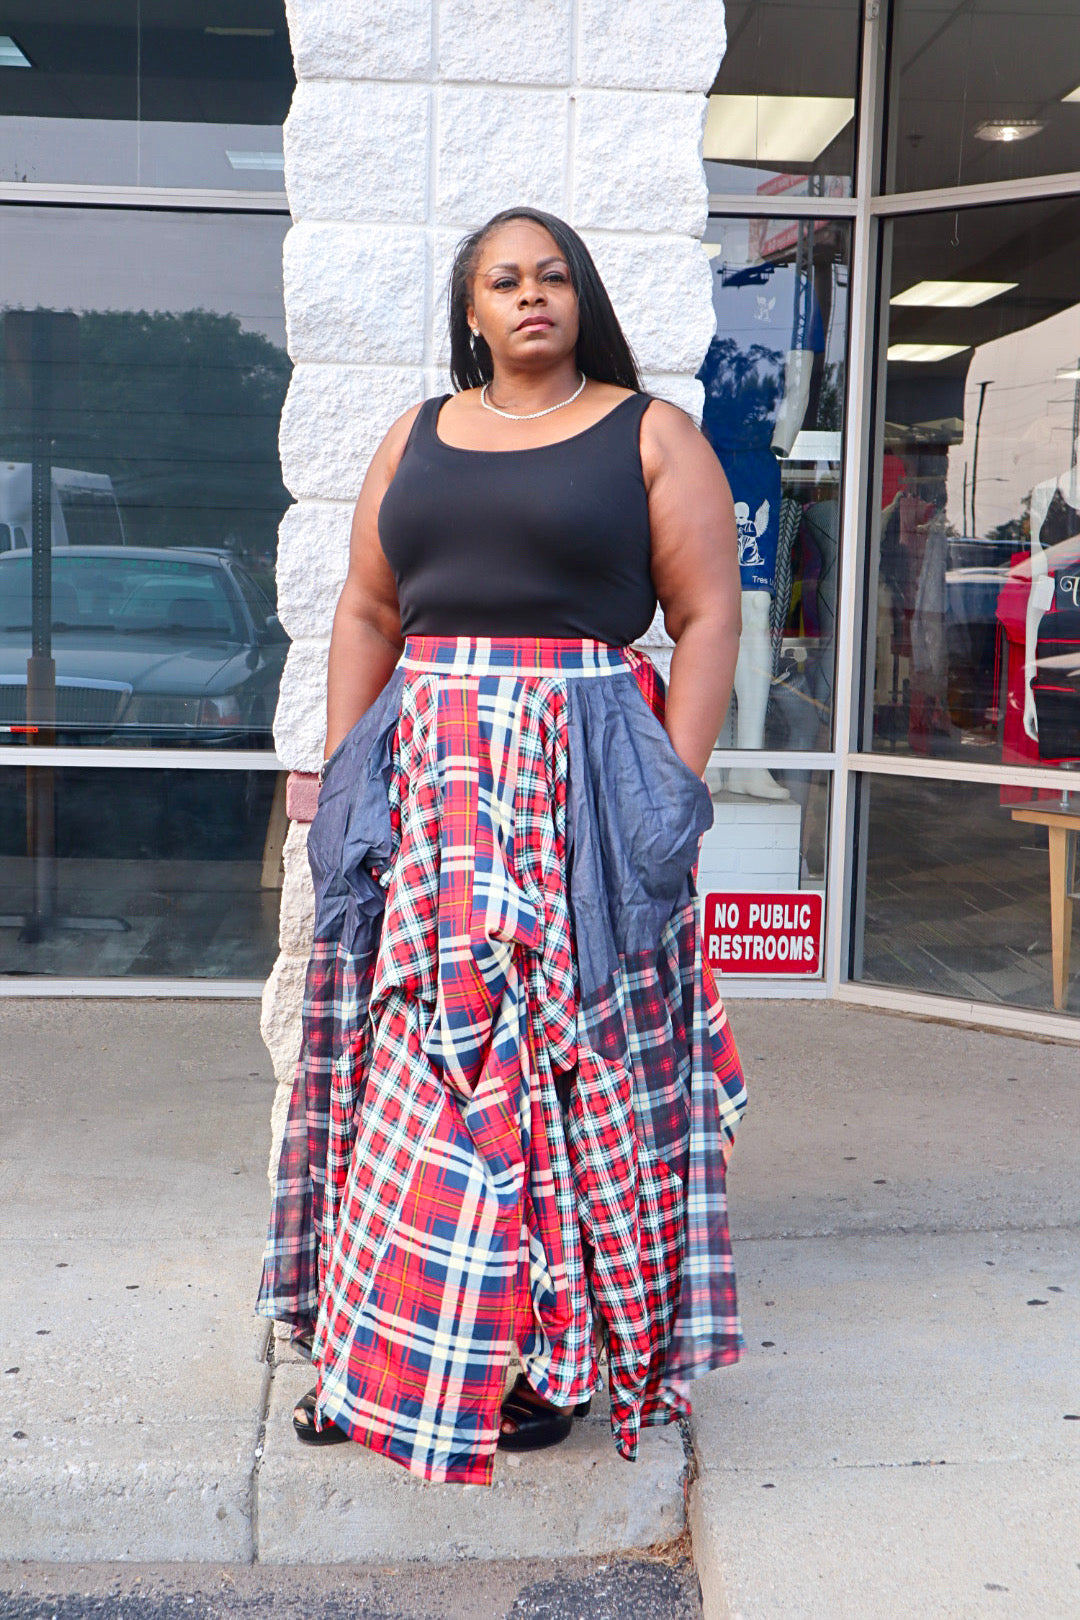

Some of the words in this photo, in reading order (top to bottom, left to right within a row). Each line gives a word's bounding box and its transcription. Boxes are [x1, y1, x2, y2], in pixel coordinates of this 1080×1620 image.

[714, 903, 740, 929] NO
[748, 903, 811, 930] PUBLIC
[708, 934, 815, 961] RESTROOMS
